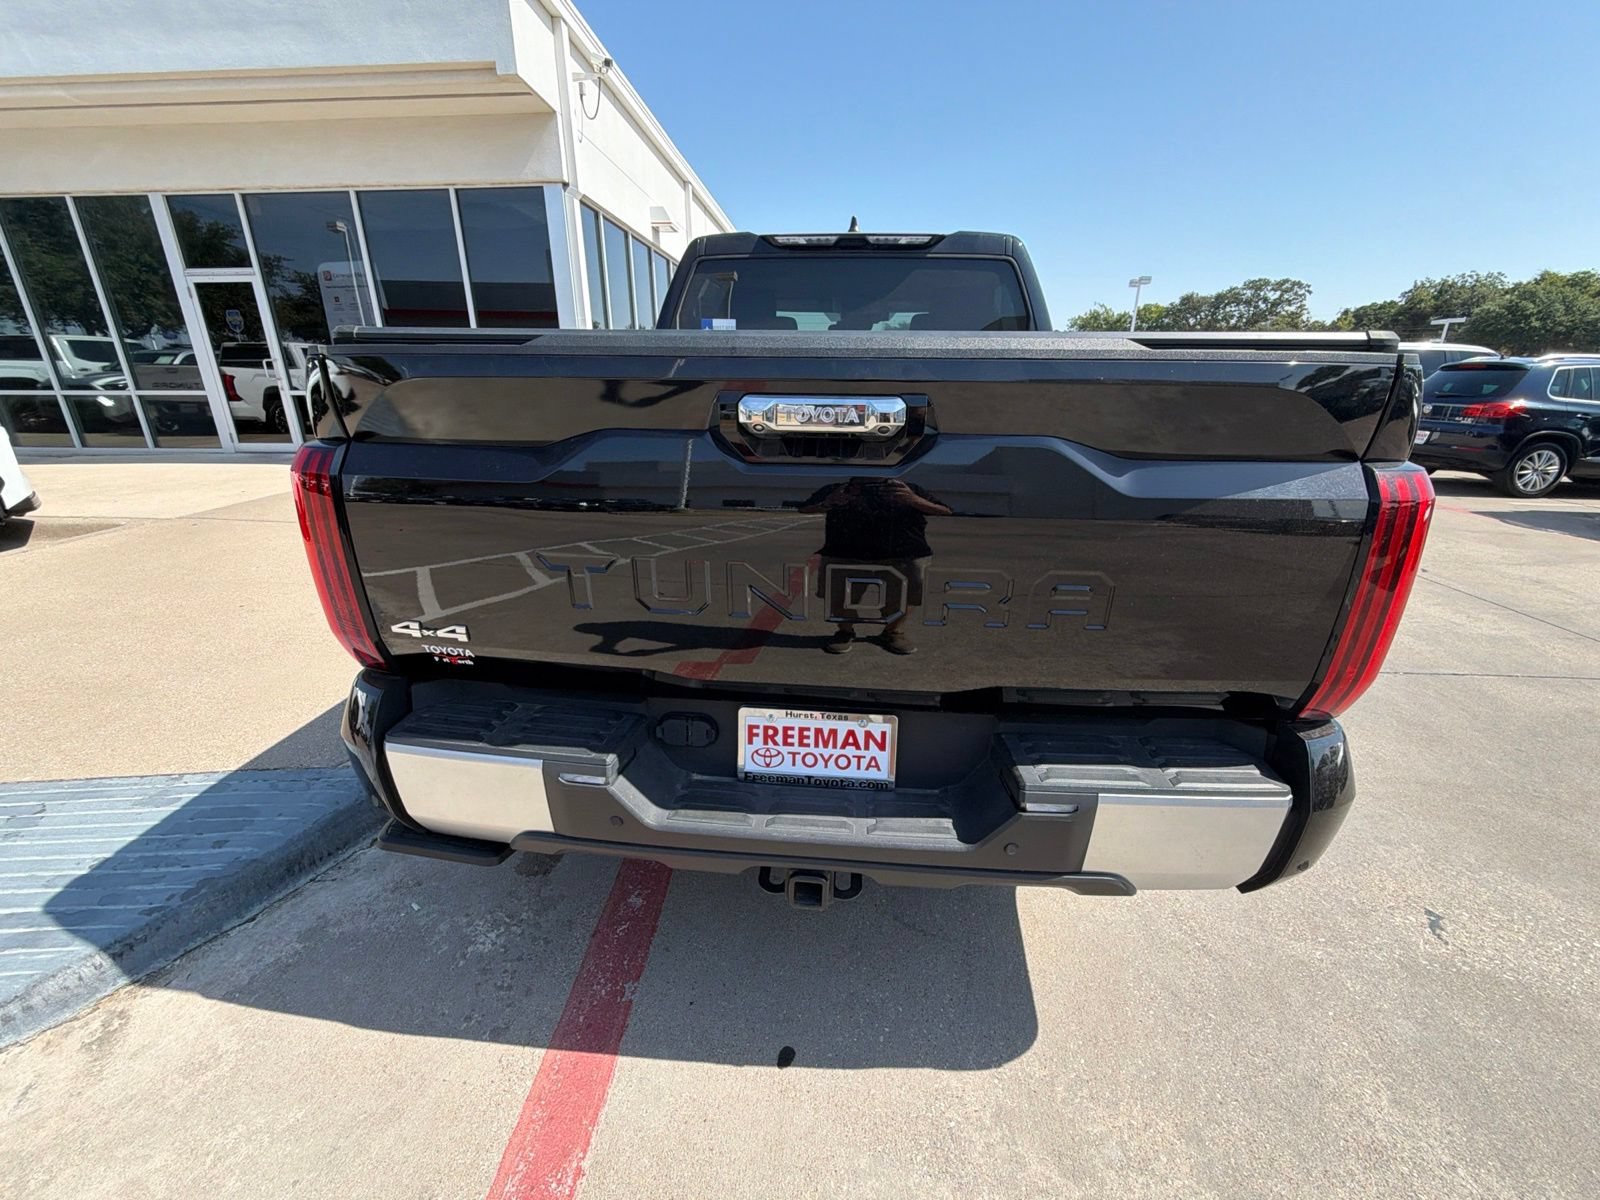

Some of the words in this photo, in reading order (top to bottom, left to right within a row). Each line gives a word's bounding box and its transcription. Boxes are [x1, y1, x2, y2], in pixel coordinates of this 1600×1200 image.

[782, 405, 860, 423] TOYOTA
[535, 551, 1117, 631] TUNDRA
[390, 620, 469, 642] 4x4
[421, 644, 475, 658] TOYOTA
[820, 712, 849, 721] Texas
[747, 724, 887, 752] FREEMAN
[787, 751, 882, 772] TOYOTA
[743, 772, 889, 790] FreemanToyota.com
